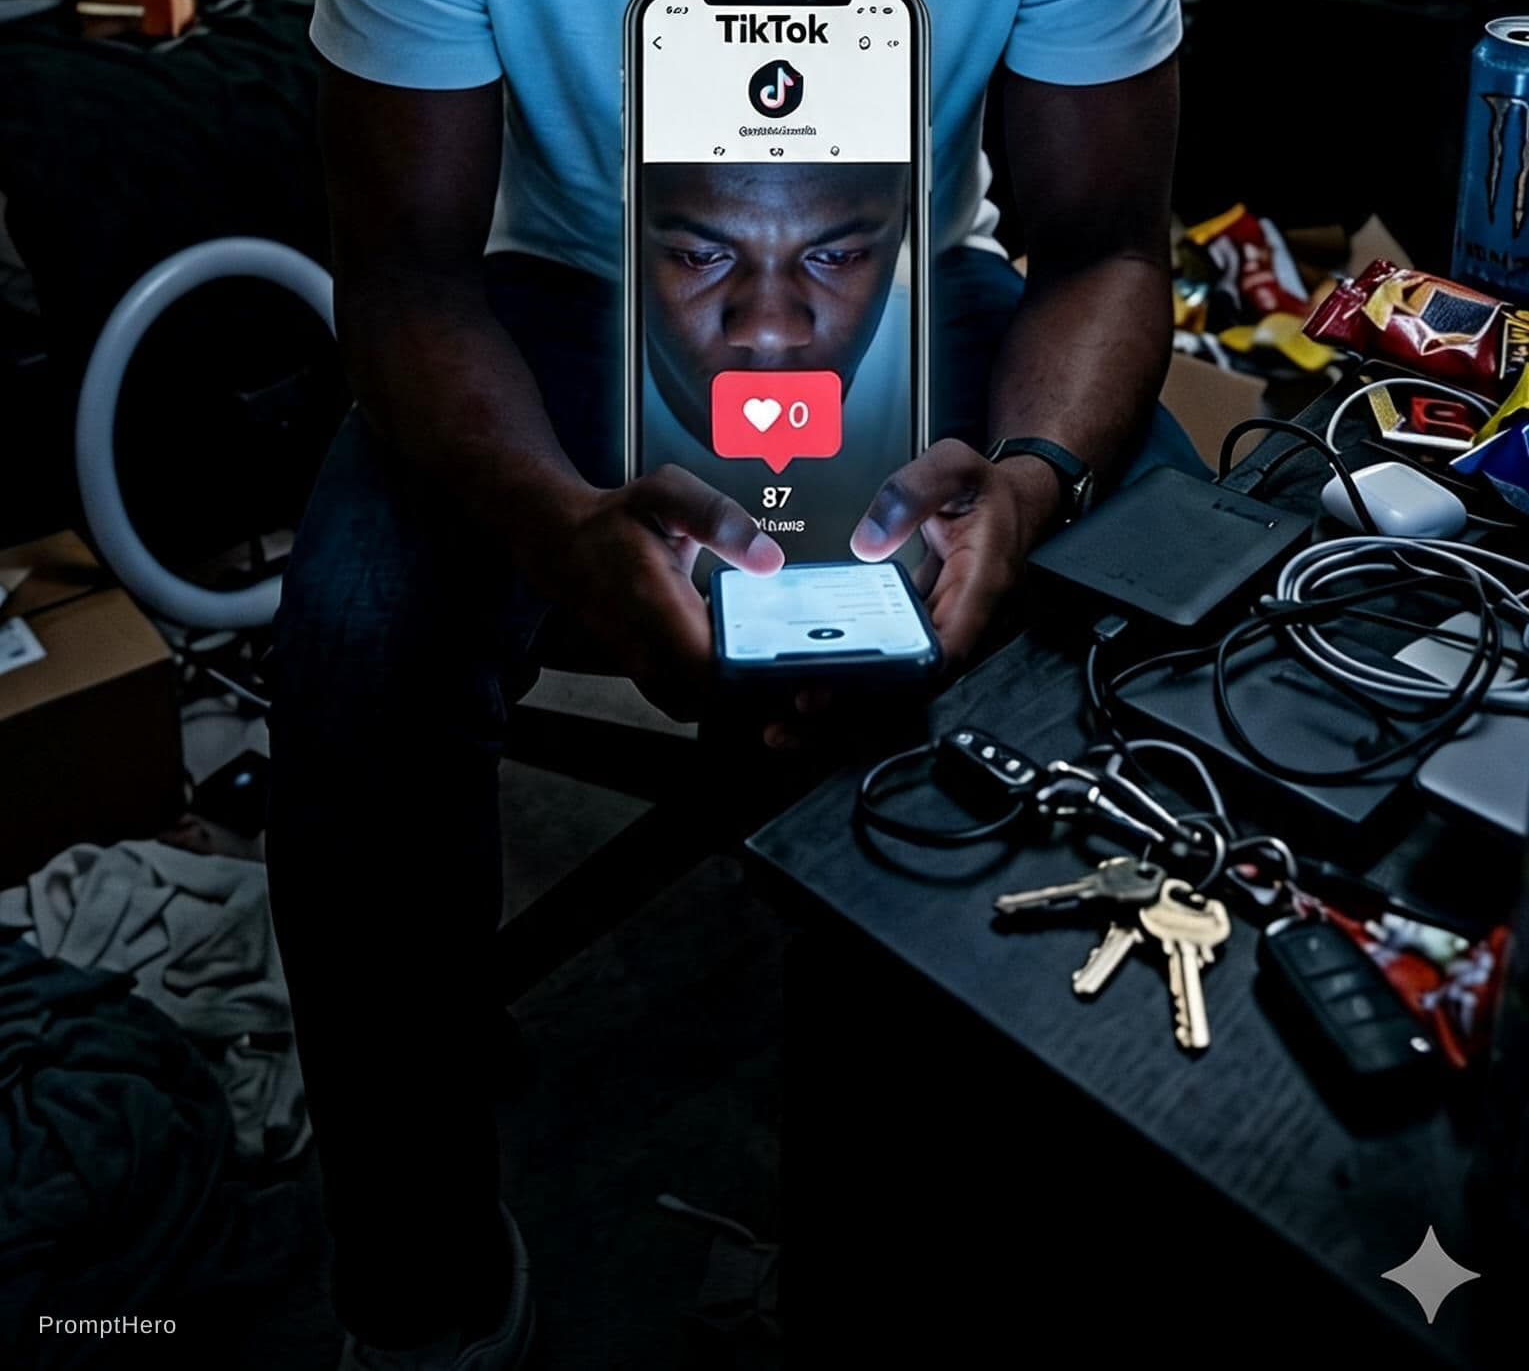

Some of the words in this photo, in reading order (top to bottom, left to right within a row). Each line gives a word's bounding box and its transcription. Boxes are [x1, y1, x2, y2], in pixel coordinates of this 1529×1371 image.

[715, 14, 829, 44] TikTok
[788, 401, 809, 428] 0
[762, 486, 793, 509] 87
